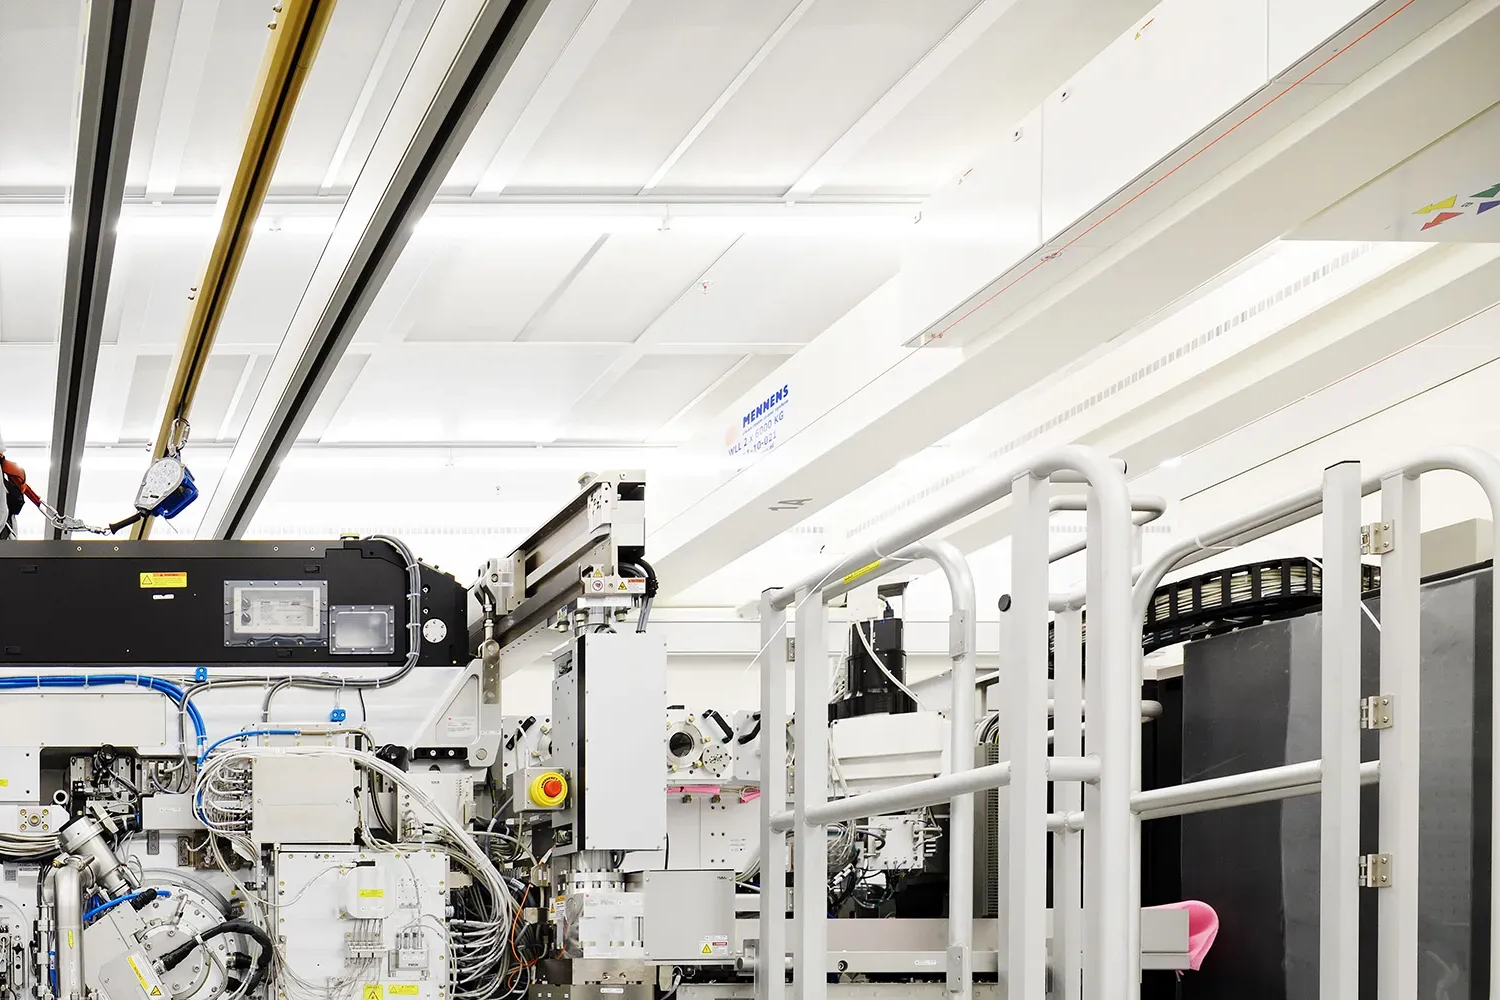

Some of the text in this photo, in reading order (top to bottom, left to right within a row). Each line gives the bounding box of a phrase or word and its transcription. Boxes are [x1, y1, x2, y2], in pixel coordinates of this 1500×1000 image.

[742, 384, 789, 428] MENNENS
[728, 443, 742, 456] WLL
[744, 437, 748, 447] 2
[755, 419, 773, 439] 6000
[773, 410, 785, 425] KG
[768, 498, 814, 511] 1A
